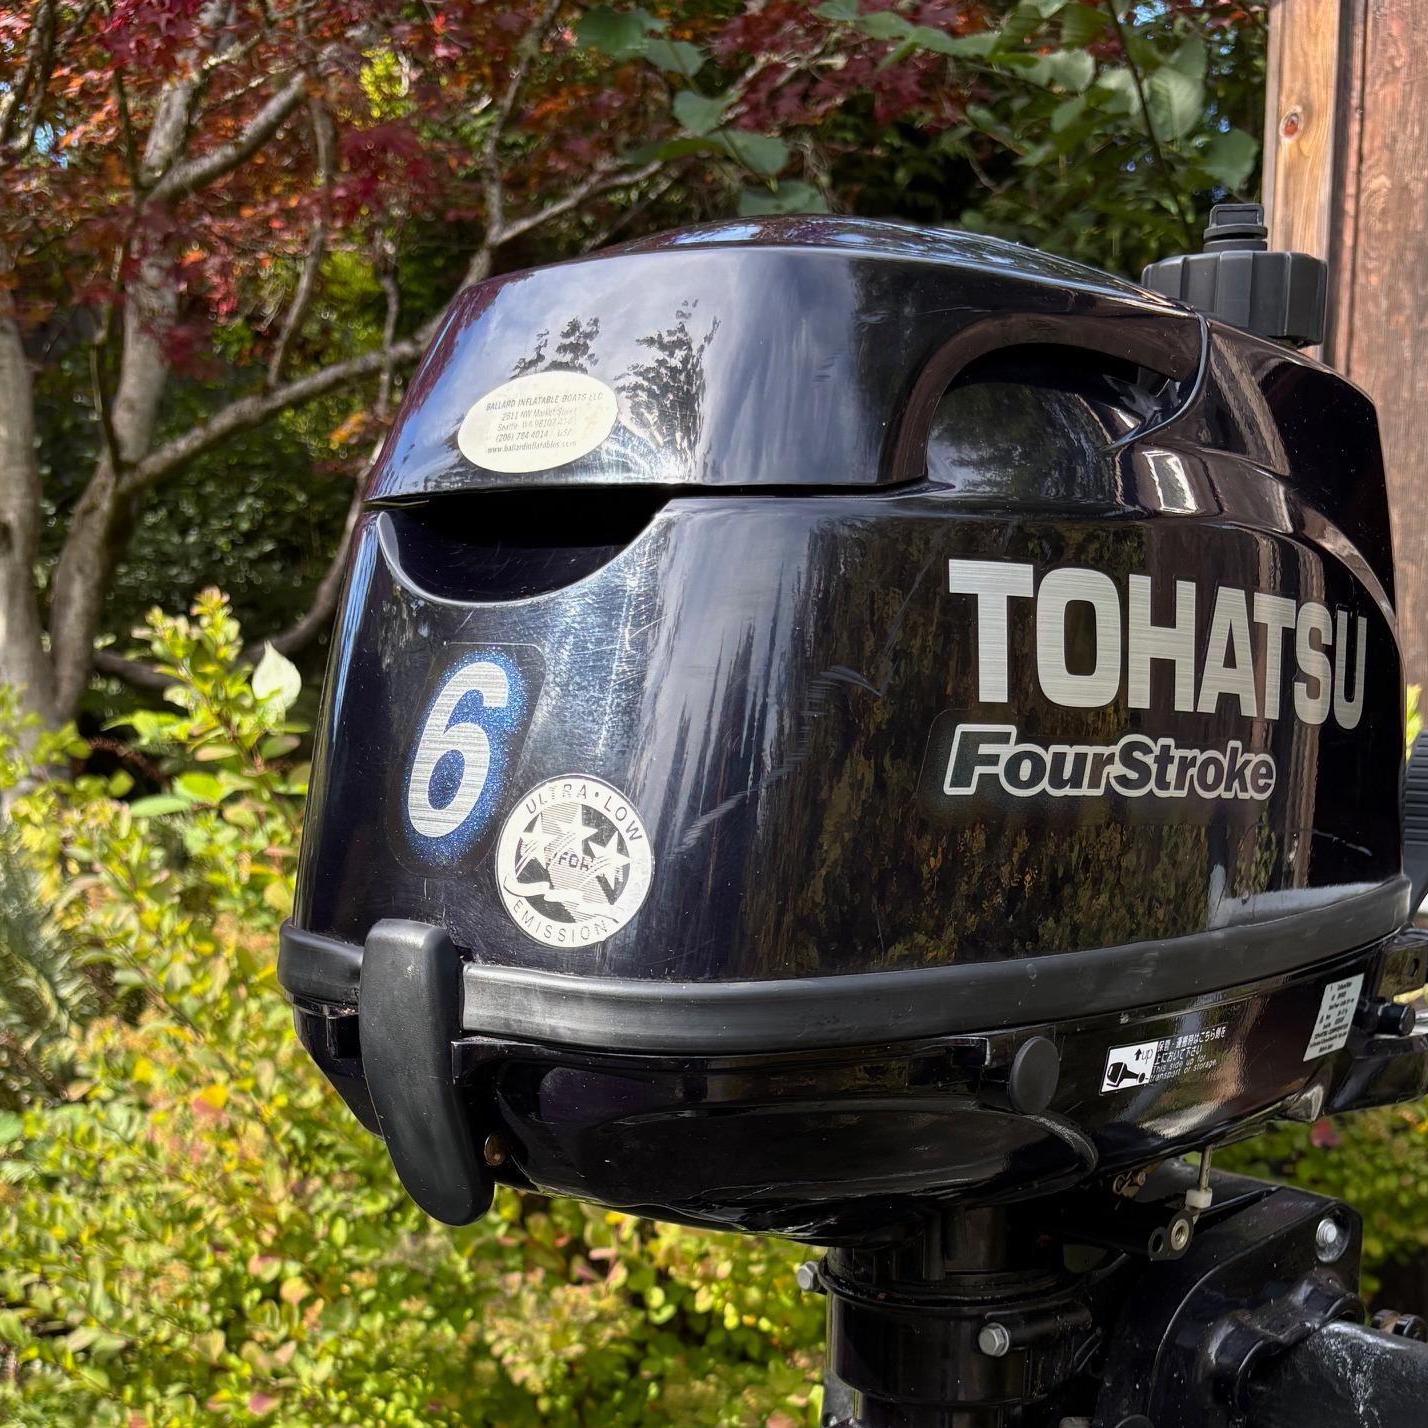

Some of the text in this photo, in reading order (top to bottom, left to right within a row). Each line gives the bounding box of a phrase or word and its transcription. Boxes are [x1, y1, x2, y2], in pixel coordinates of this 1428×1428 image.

[486, 399, 516, 411] BALLARD
[518, 395, 559, 407] INFLATABLE
[562, 393, 587, 403] BOATS
[949, 559, 1367, 730] TOHATSU
[408, 661, 509, 838] 6
[943, 723, 1276, 800] FourStroke
[526, 782, 643, 843] ULTRA LOW
[512, 899, 609, 943] EMISSION
[1141, 1048, 1154, 1065] up
[1149, 1068, 1181, 1083] transport
[1184, 1066, 1192, 1074] or
[1152, 1054, 1207, 1075] This side up for
